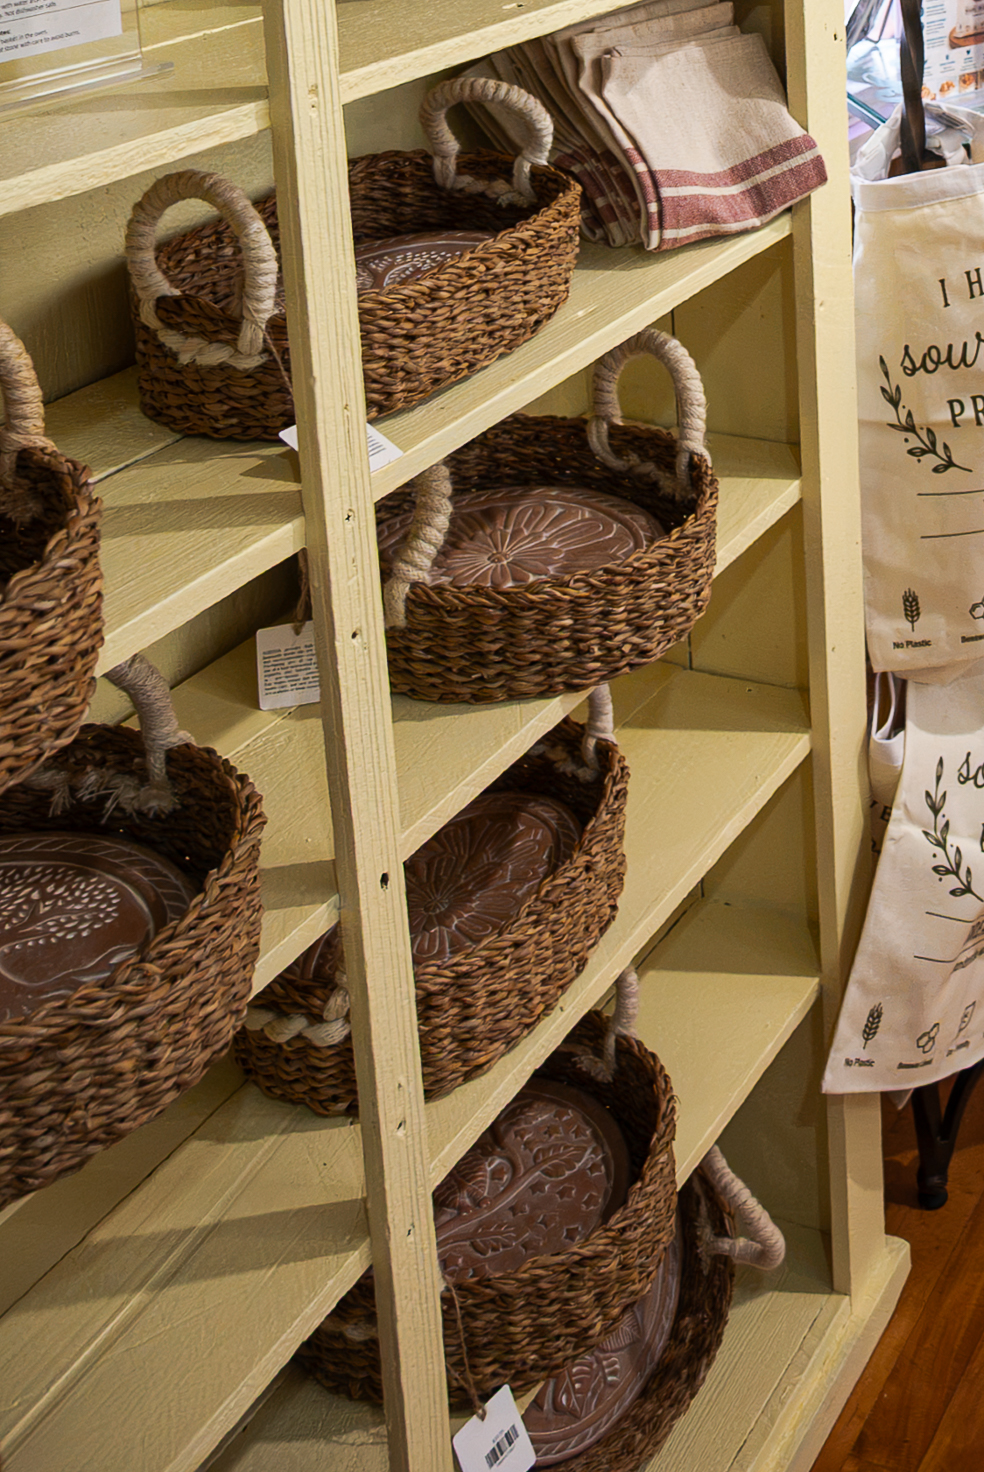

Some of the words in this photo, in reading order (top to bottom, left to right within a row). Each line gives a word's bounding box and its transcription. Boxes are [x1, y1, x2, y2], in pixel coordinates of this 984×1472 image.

[938, 278, 950, 308] I
[892, 641, 904, 650] No
[906, 638, 932, 648] Plastic
